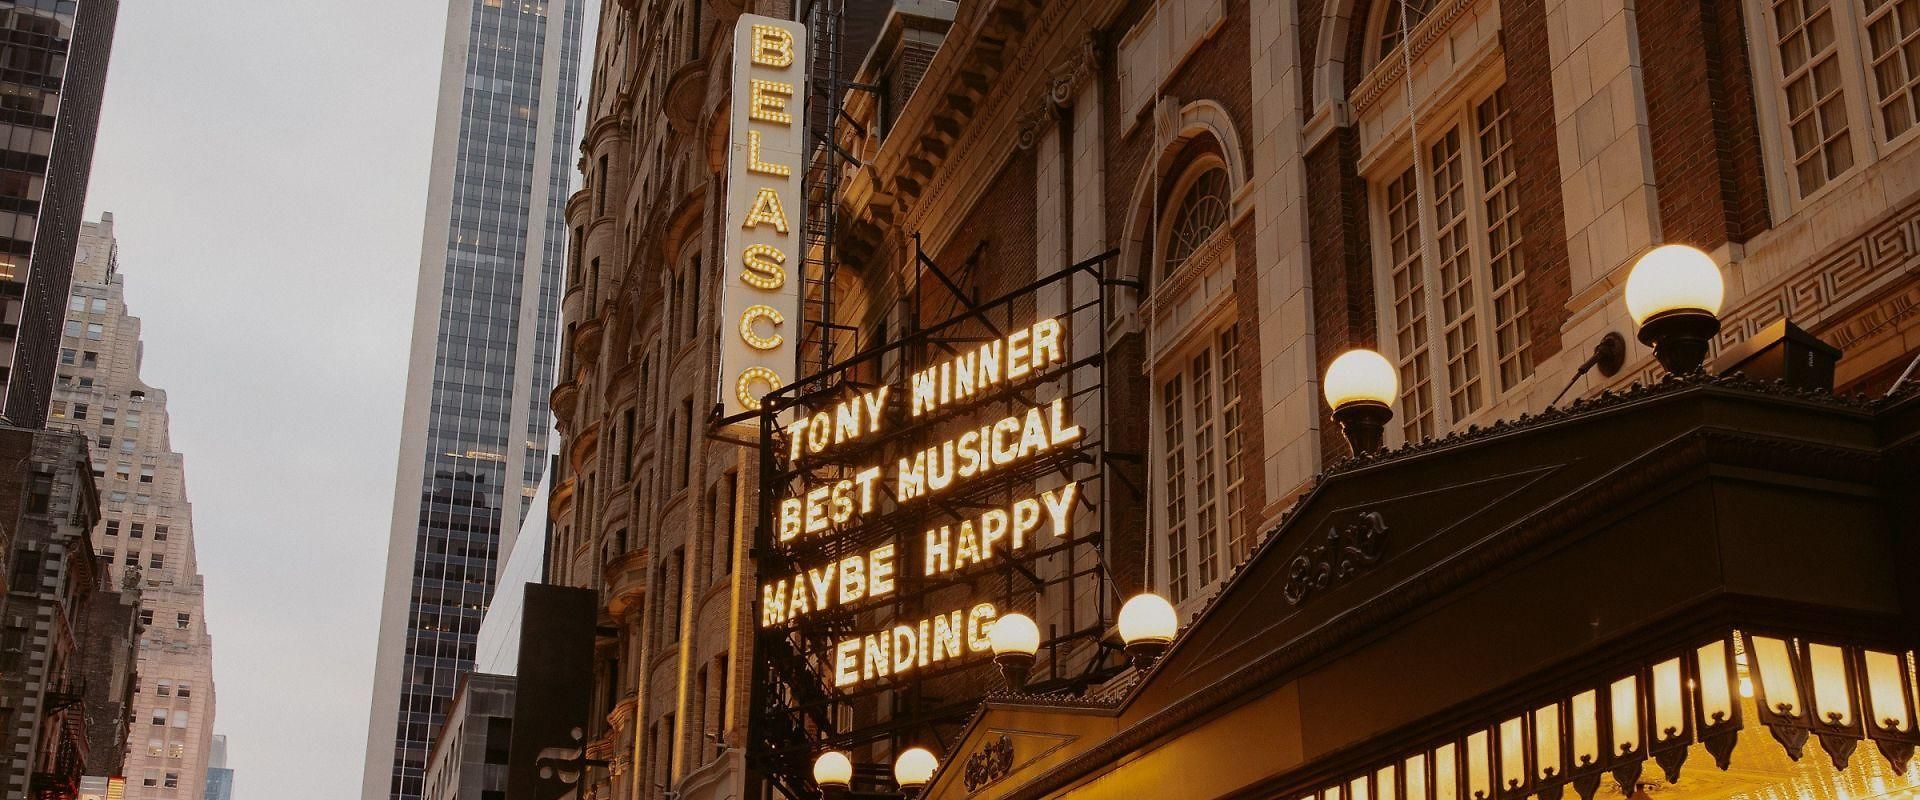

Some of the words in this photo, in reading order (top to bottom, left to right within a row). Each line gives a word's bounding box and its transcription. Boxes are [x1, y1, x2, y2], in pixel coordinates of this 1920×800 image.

[736, 24, 794, 410] BELASCO
[786, 386, 889, 461] TONY
[910, 317, 1064, 416] WINNER
[779, 467, 880, 542] BEST
[897, 398, 1080, 502] MUSICAL
[762, 543, 896, 627] MAYBE
[924, 481, 1078, 577] HAPPY
[834, 602, 996, 688] ENDING
